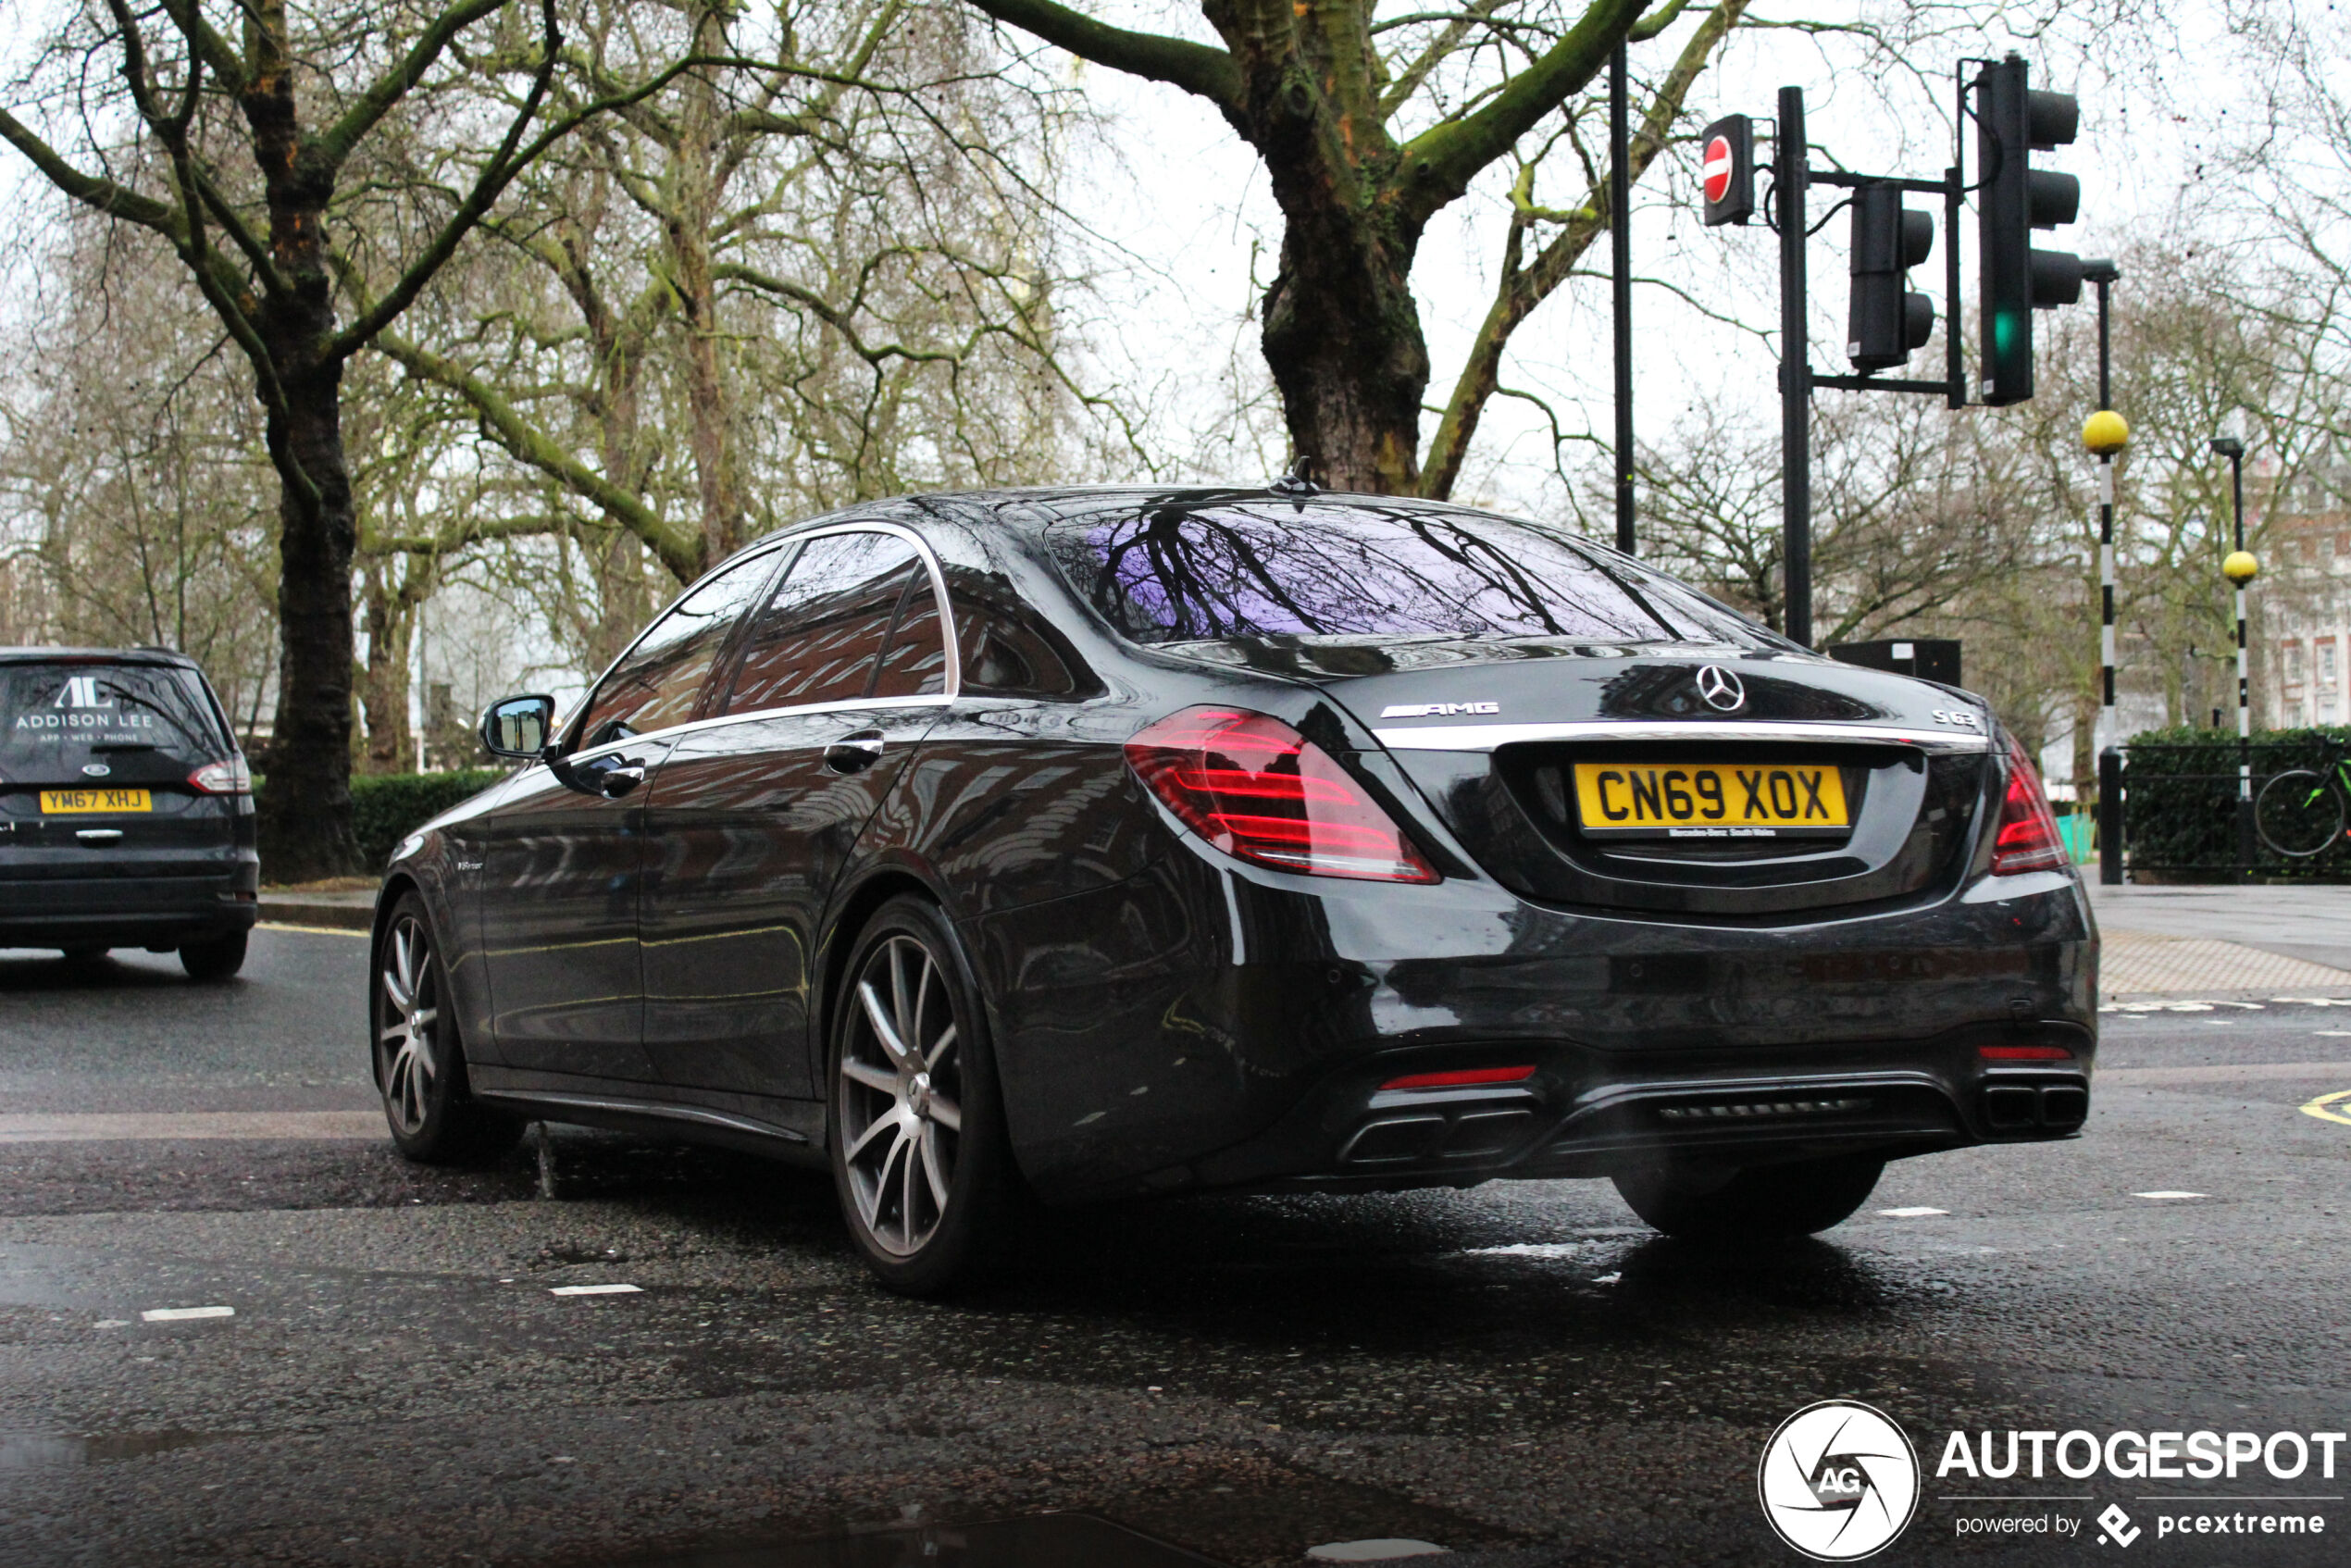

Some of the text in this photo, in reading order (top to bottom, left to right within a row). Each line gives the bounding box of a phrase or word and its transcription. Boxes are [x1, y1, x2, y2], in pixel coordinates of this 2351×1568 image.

[1416, 702, 1499, 716] AMG
[16, 714, 153, 728] ADDISON LEE
[1932, 709, 1977, 727] S 63
[40, 733, 138, 742] APP WEB PHONE
[48, 790, 142, 808] YM67 XHJ
[1597, 770, 1830, 820] CN69 XOX
